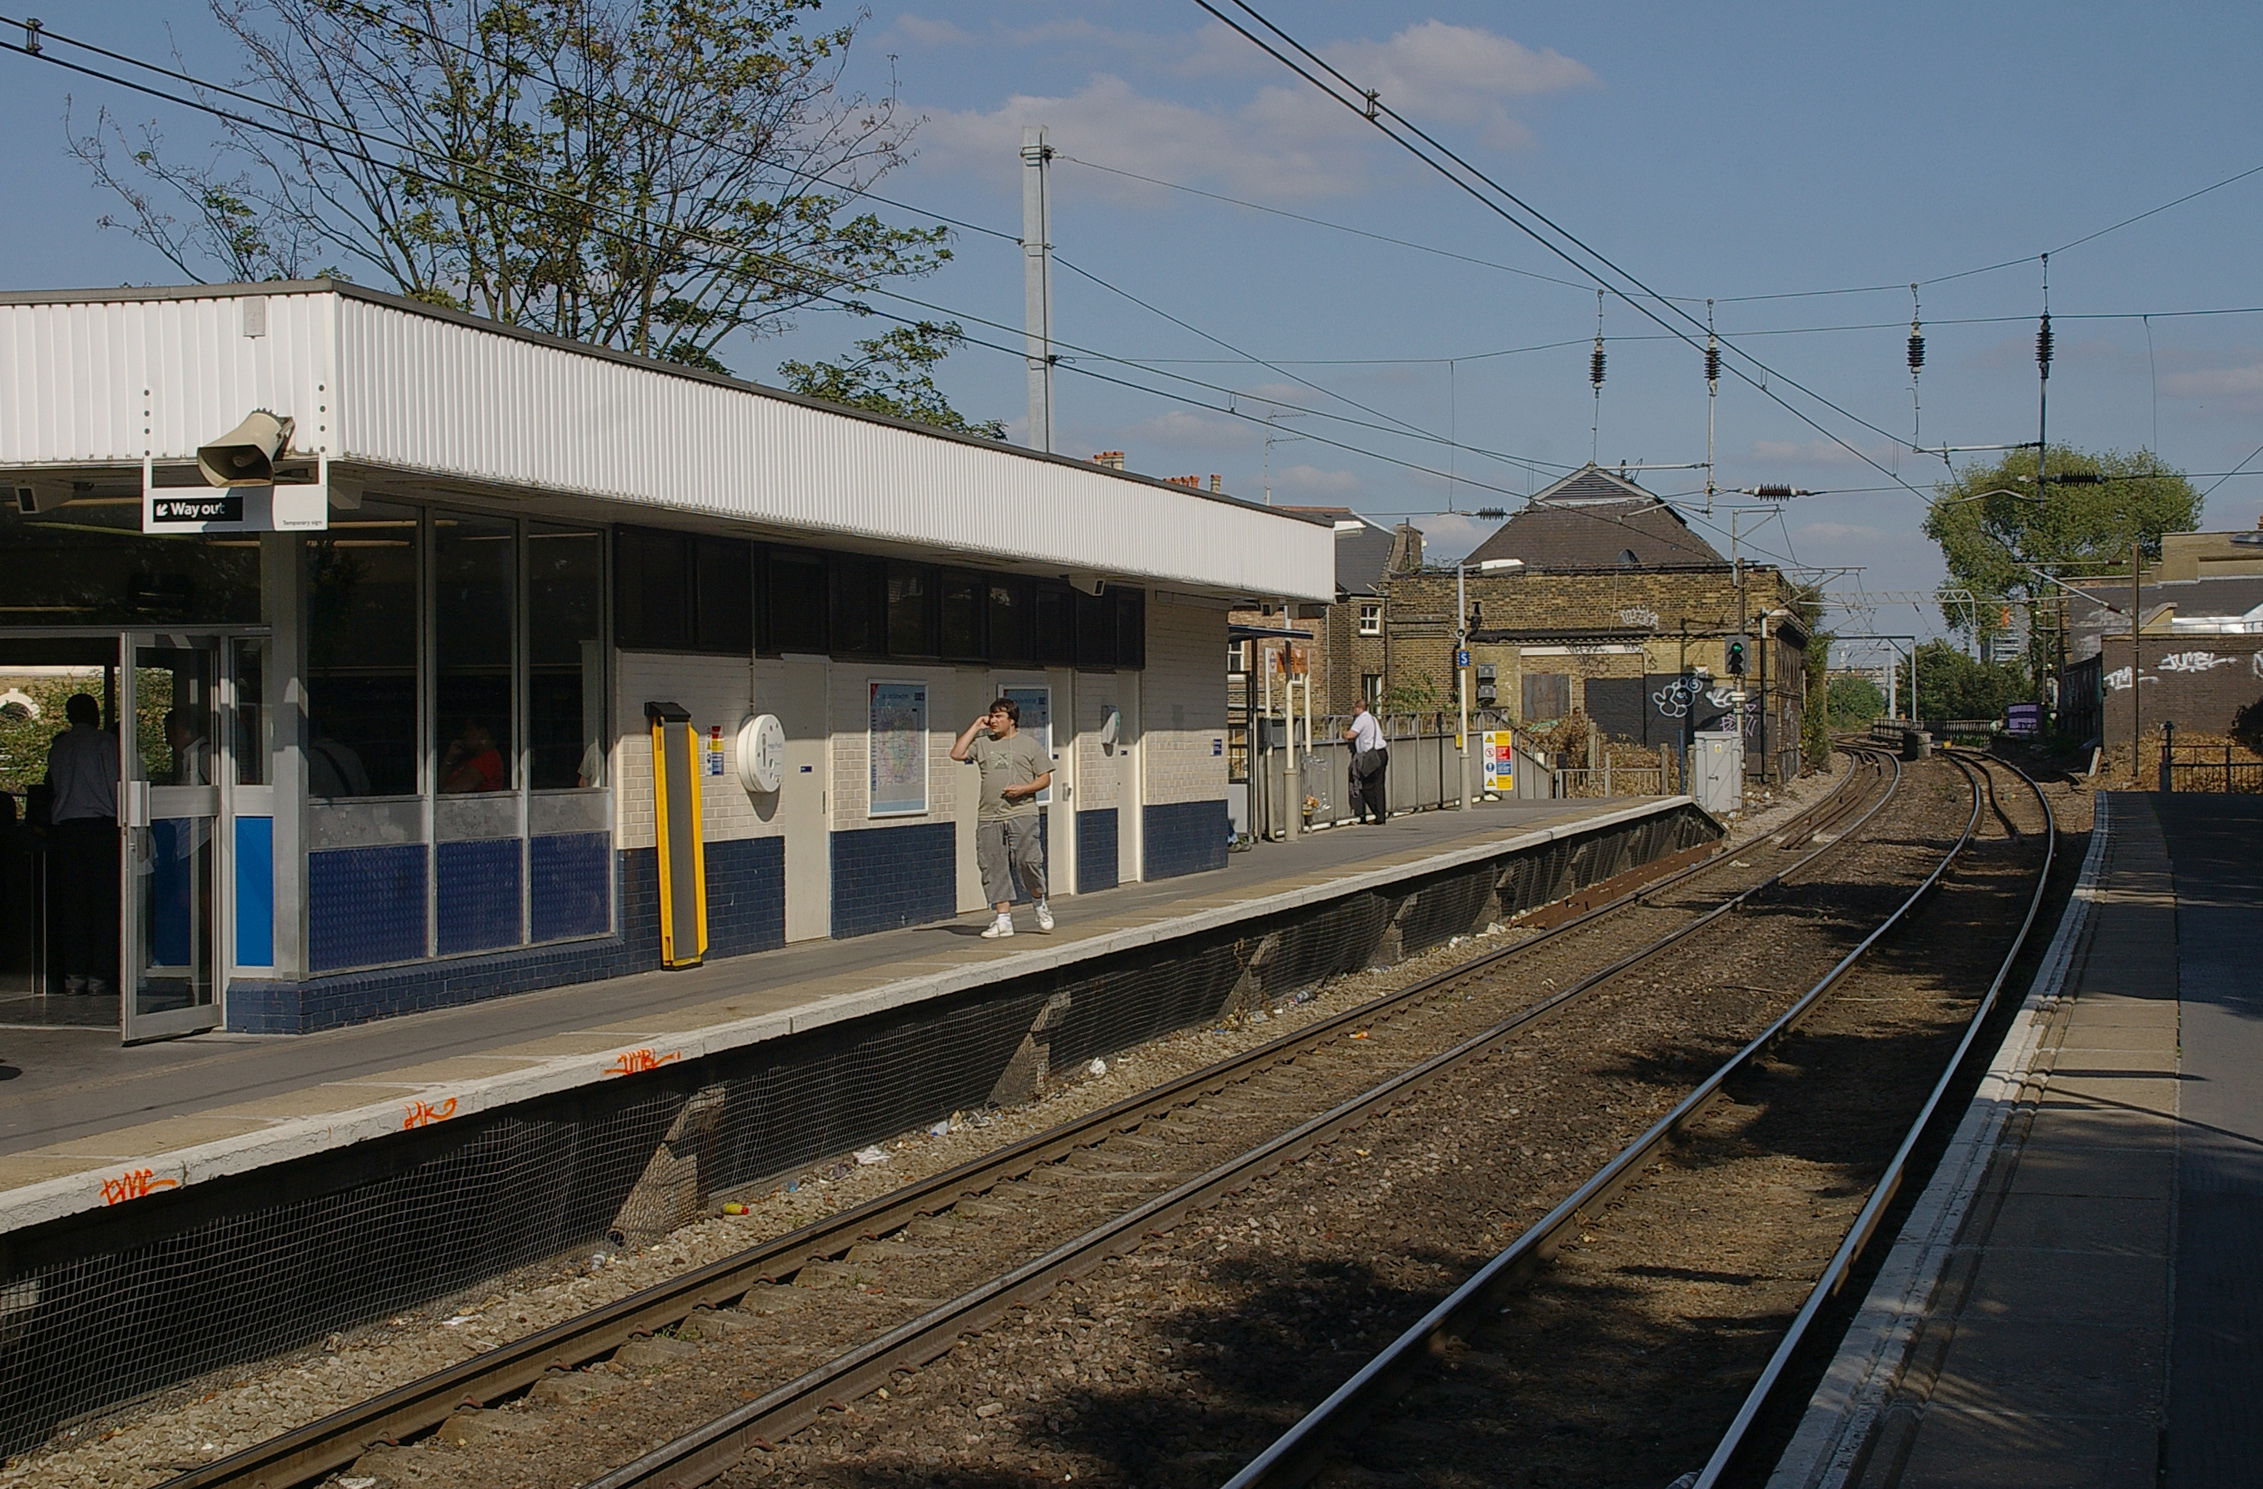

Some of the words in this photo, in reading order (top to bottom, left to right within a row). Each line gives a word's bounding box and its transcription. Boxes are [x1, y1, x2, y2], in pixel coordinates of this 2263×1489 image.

[170, 502, 200, 518] Way
[201, 502, 225, 515] out
[1460, 653, 1468, 664] S
